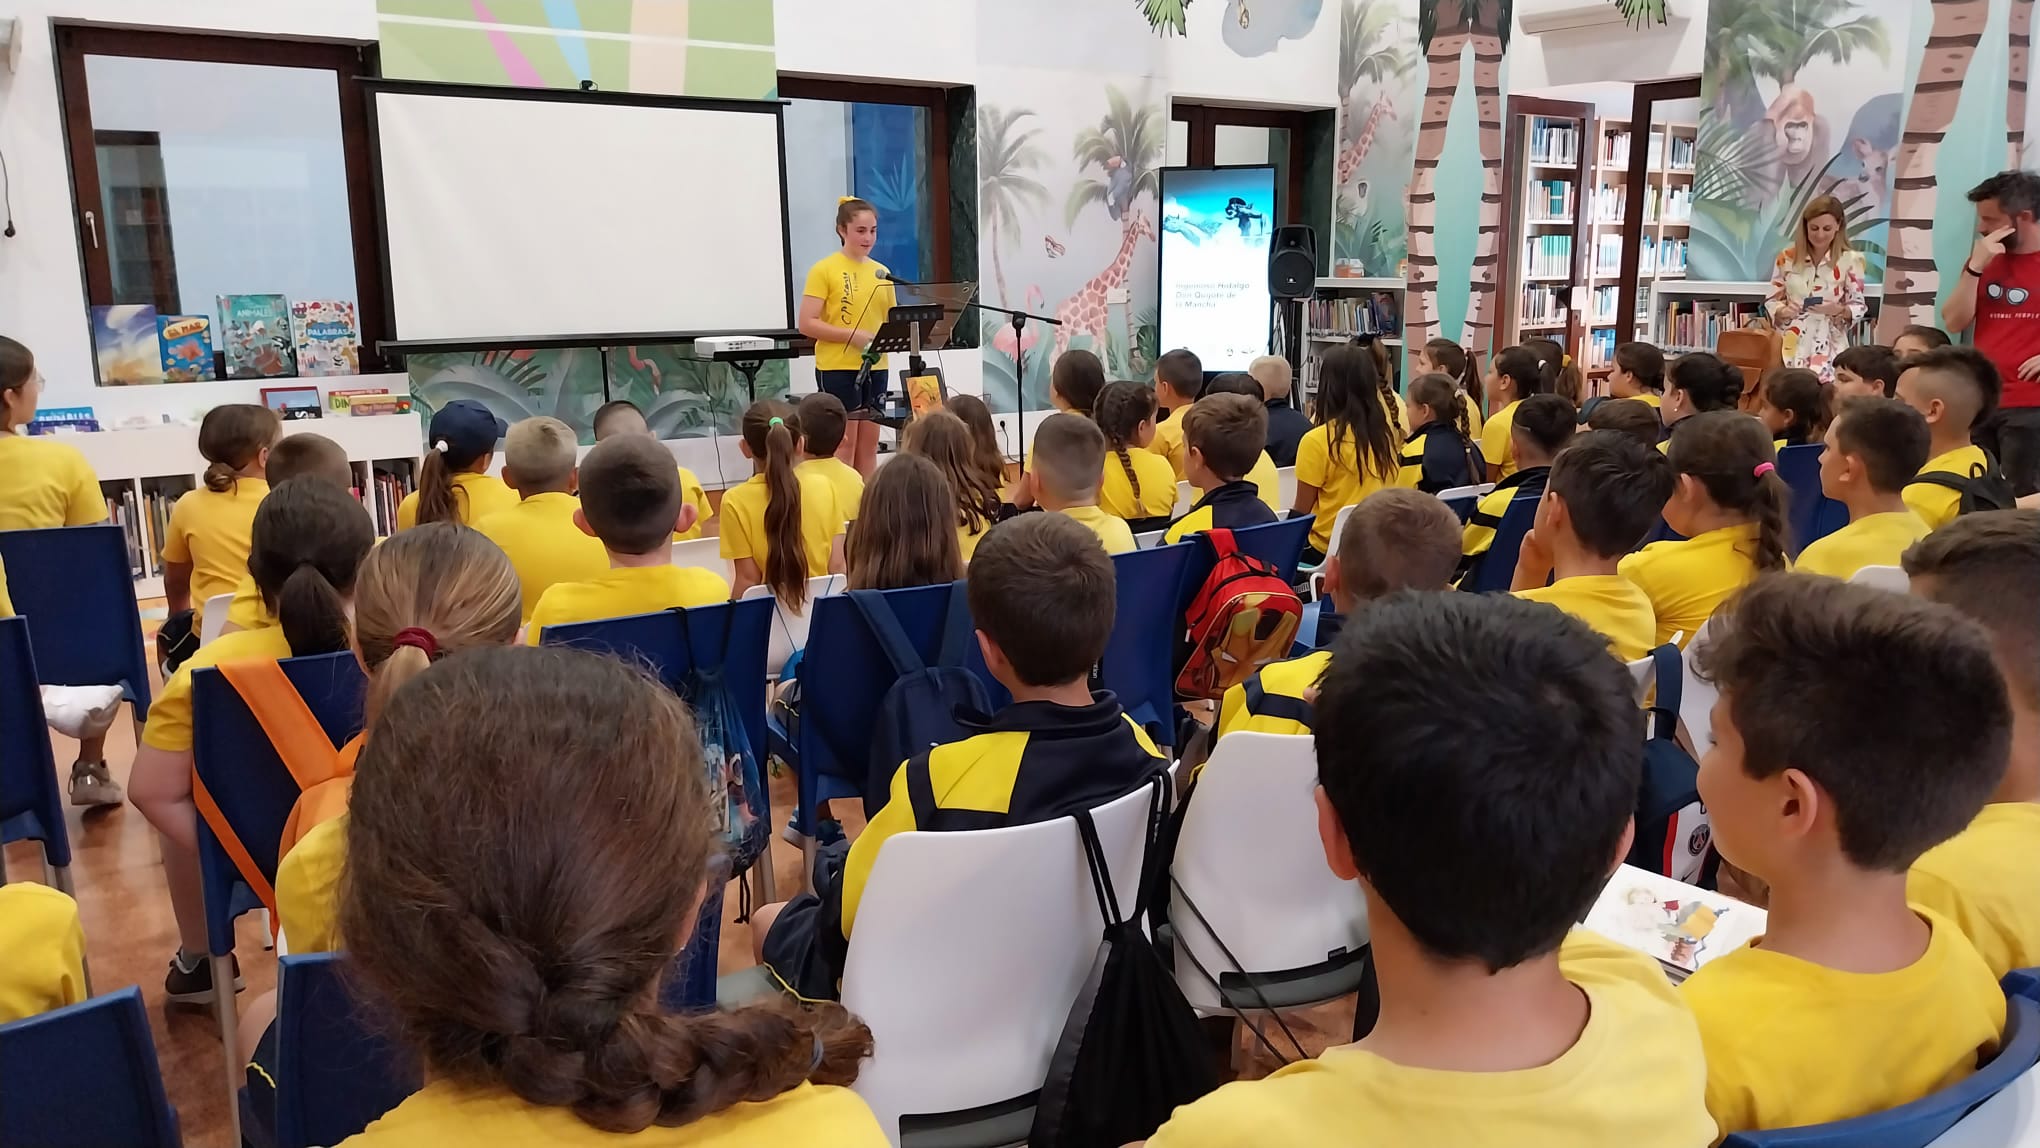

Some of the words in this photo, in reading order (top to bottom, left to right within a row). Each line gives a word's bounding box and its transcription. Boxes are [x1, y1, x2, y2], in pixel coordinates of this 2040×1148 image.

[1217, 282, 1250, 291] Hidalgo
[1184, 301, 1216, 309] Mancha
[181, 322, 203, 335] MAR
[307, 327, 349, 337] PALABRAS
